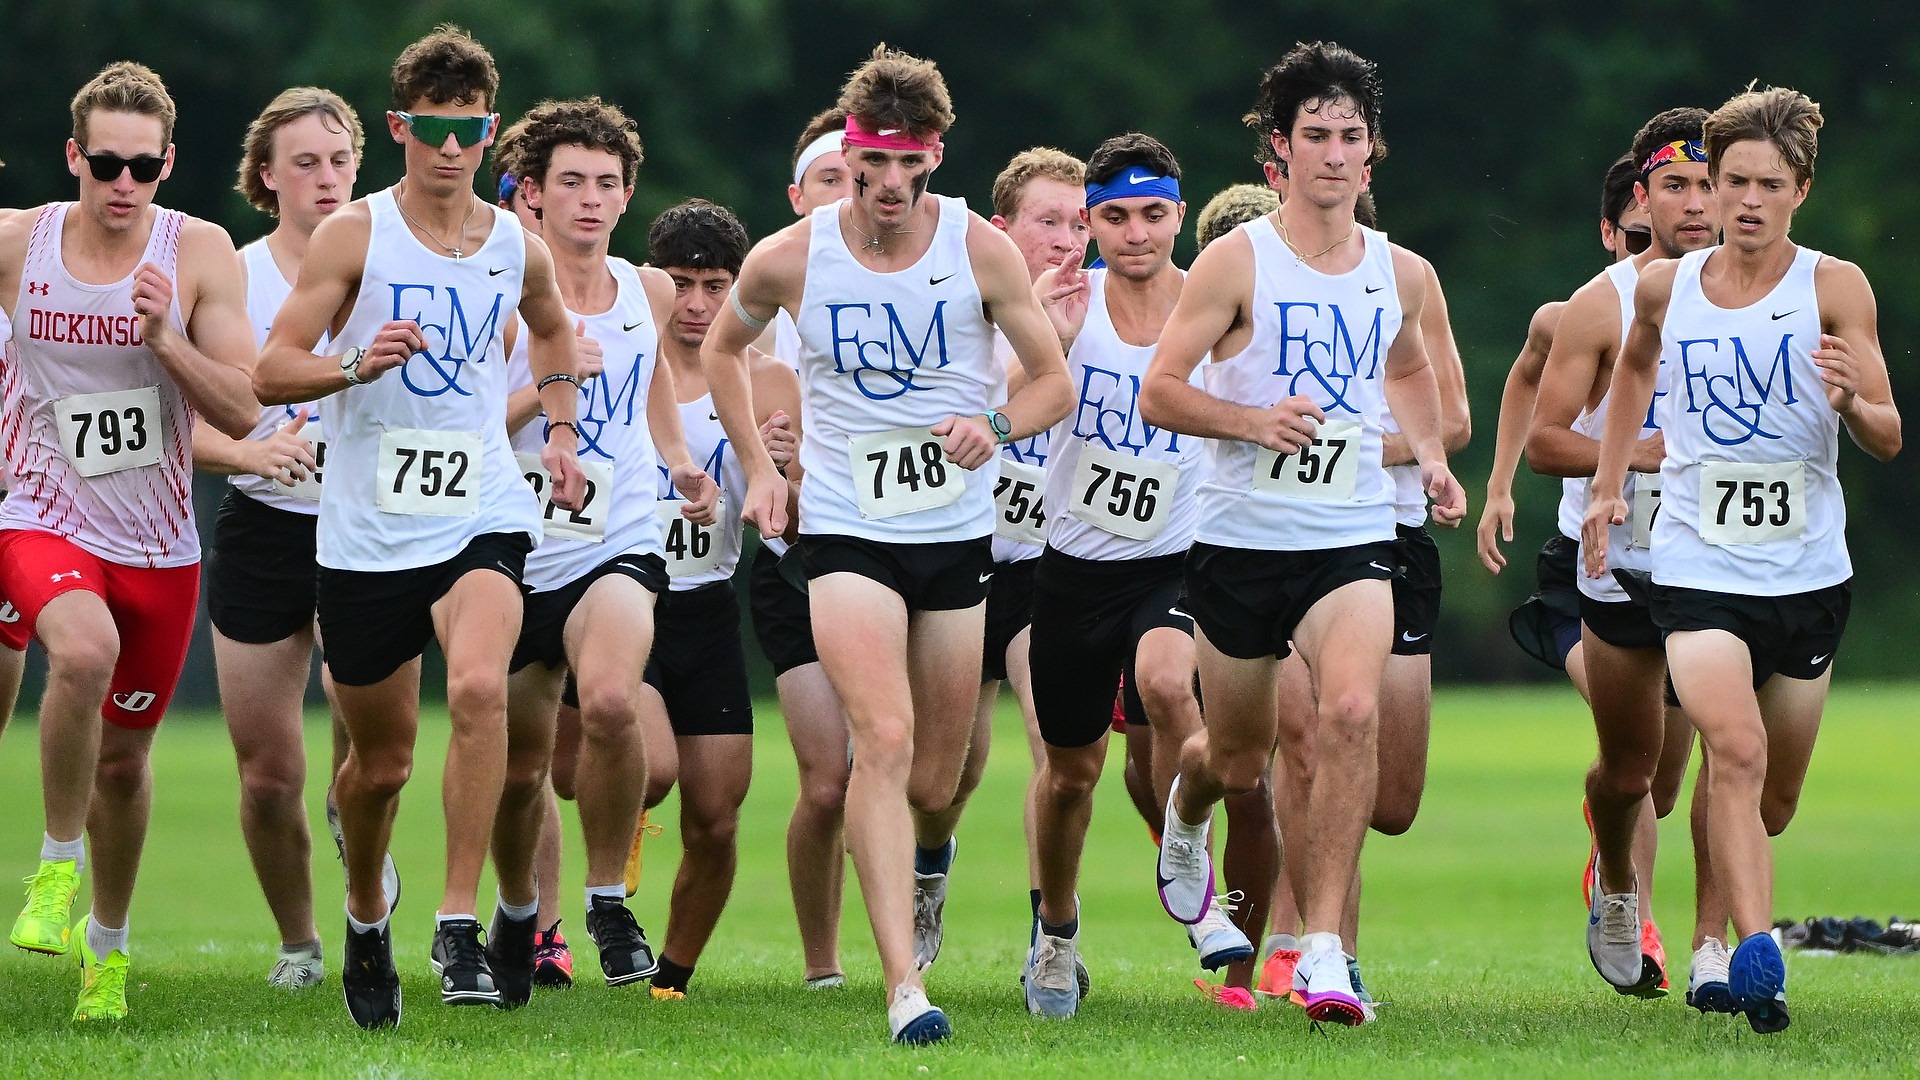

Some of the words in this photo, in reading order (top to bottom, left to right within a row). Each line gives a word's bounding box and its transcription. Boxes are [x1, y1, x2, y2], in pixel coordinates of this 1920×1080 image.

[826, 300, 951, 401] F&M
[1273, 301, 1385, 415] F&M
[1678, 333, 1799, 446] F&M
[71, 407, 147, 458] 793
[1270, 436, 1347, 484] 757
[393, 447, 468, 497] 752
[866, 441, 946, 499] 748
[1082, 463, 1160, 522] 756
[992, 475, 1047, 529] 754
[1716, 480, 1790, 527] 753
